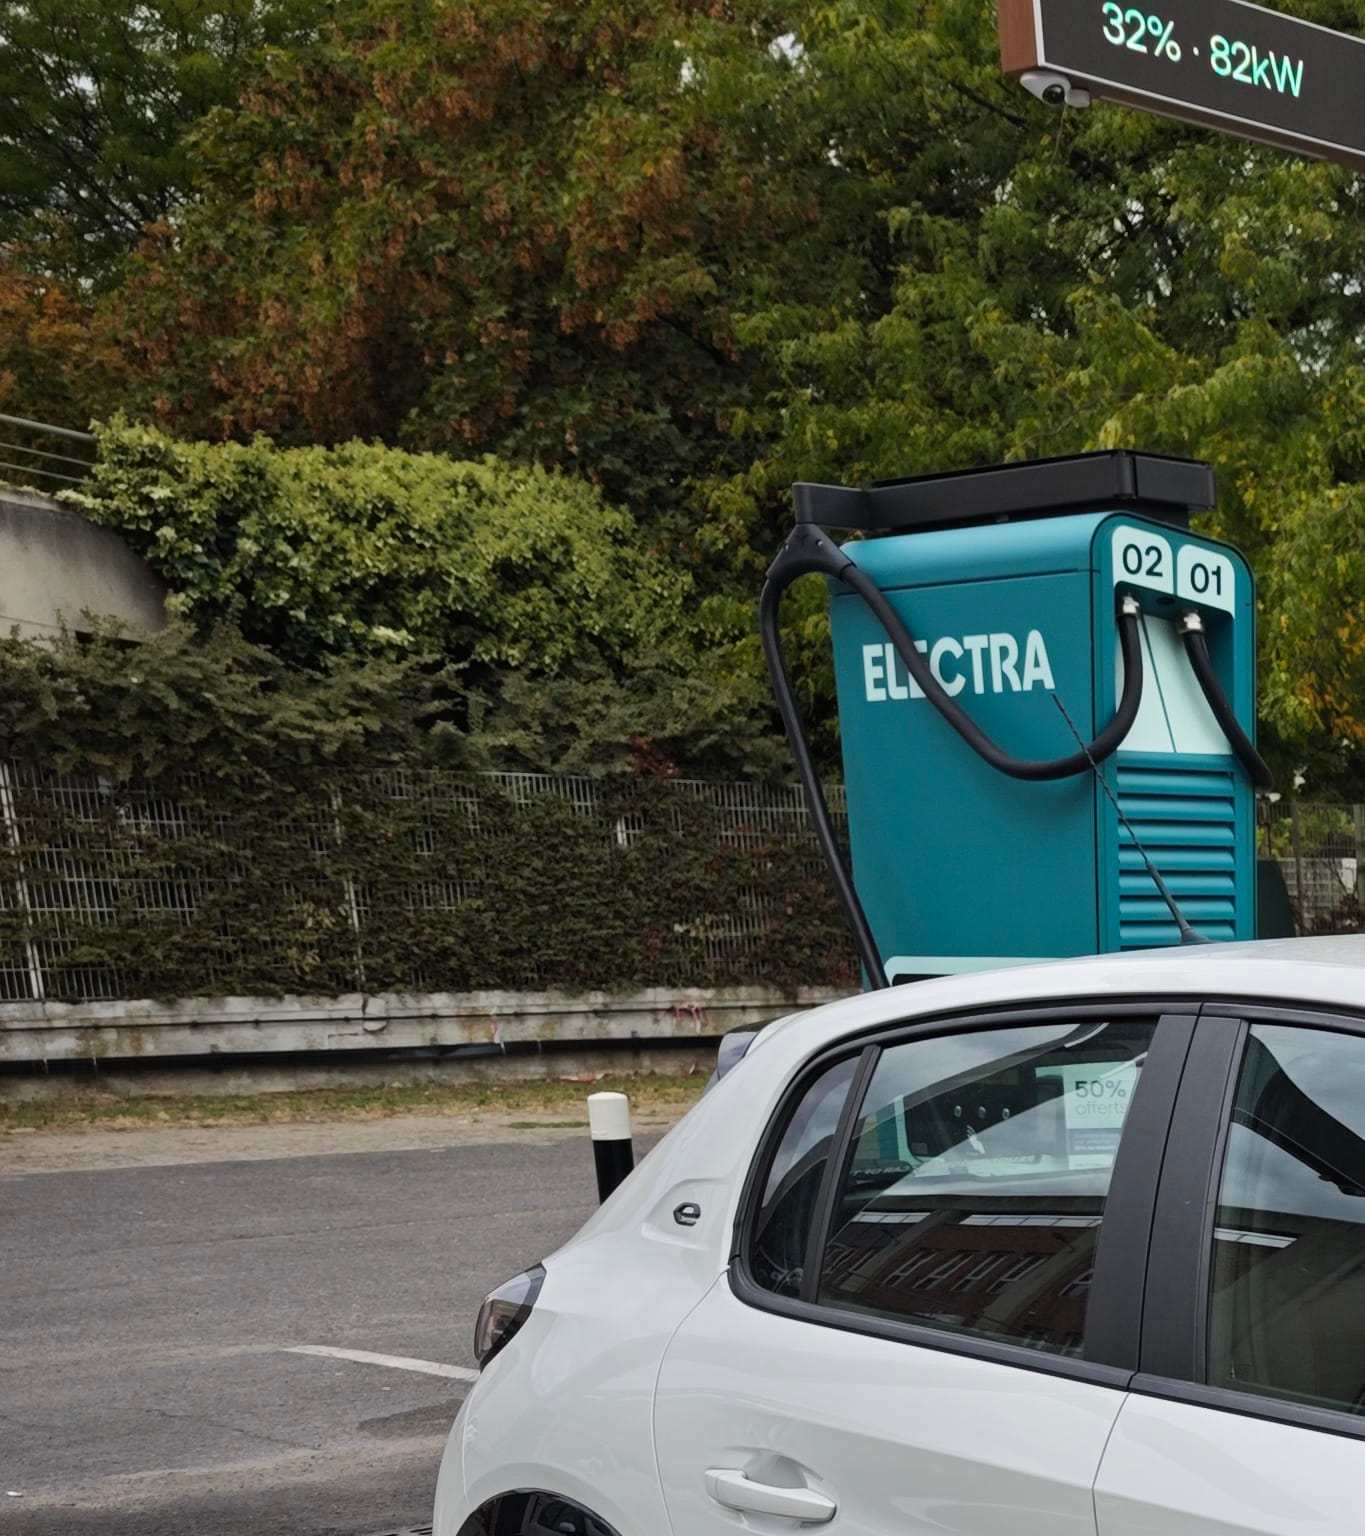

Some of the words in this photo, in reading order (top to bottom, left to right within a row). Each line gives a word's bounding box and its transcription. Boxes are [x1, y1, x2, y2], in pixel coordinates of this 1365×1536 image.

[1102, 1, 1181, 62] 32%
[1210, 34, 1303, 98] 82kW
[1122, 543, 1163, 577] 02
[1190, 562, 1221, 596] 01
[1075, 1080, 1127, 1098] 50%
